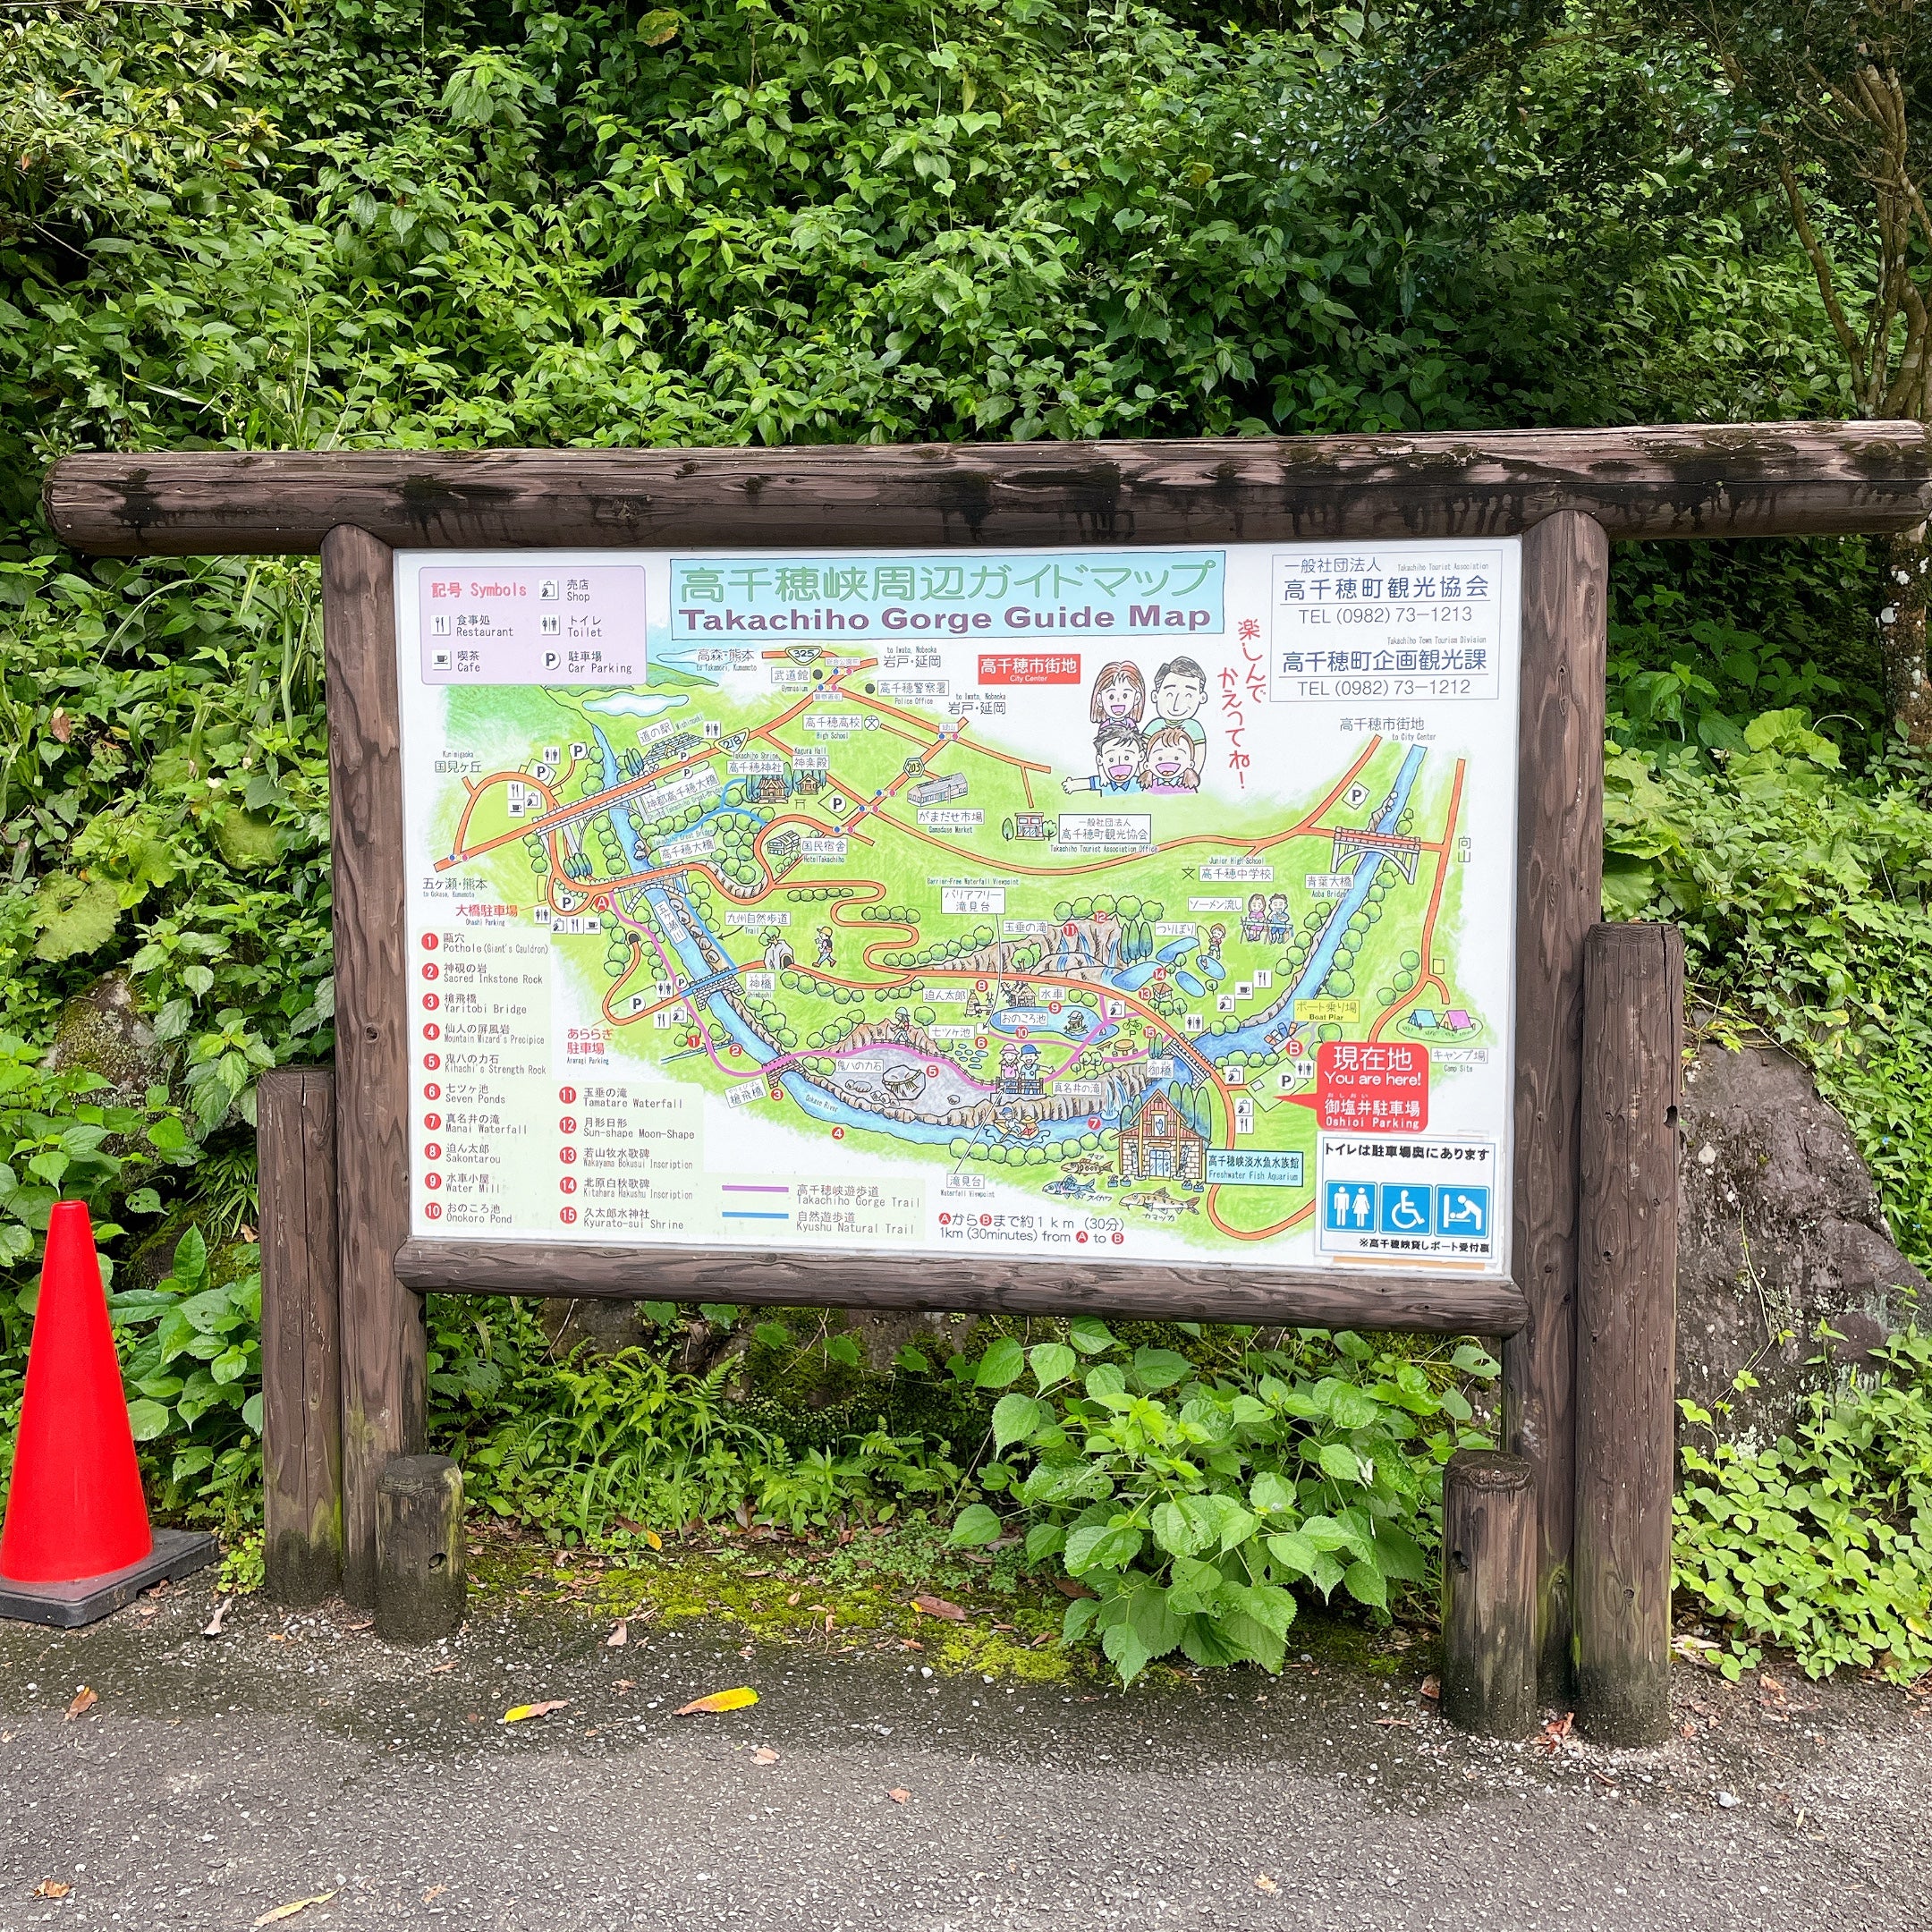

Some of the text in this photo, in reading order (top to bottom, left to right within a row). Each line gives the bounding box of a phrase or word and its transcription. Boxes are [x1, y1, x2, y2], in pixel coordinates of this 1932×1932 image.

[1284, 556, 1381, 573] 一般社団法人
[567, 579, 589, 591] 売店
[679, 560, 1216, 602] 高千穂峡周辺ガイドマップ
[431, 582, 527, 599] 記号 Symbols
[1284, 575, 1488, 601] 高千穂町観光協会
[567, 592, 589, 603] Shop
[456, 614, 490, 625] 食事処
[570, 615, 602, 625] トイレ
[679, 605, 1210, 634] Takachiho Gorge Guide Map
[1299, 609, 1332, 624] TEL
[1336, 607, 1391, 624] (0982)
[456, 627, 513, 637] Restaurant
[568, 627, 602, 638] Toilet
[457, 650, 479, 661] 喫茶
[568, 650, 602, 662] 駐車場
[698, 648, 754, 662] 高森・熊本
[793, 649, 815, 658] 325
[883, 655, 941, 668] 岩戸・延岡
[980, 657, 1077, 674] 高千穂市街地
[1238, 618, 1266, 703] 楽しんで
[1283, 648, 1487, 673] 高千穂町企画観光課
[457, 662, 480, 672] Cafe
[568, 664, 632, 674] Car Parking
[774, 670, 809, 682] 武道館
[1009, 674, 1048, 683] City Center
[879, 682, 946, 694] 高千穂警察署
[1297, 681, 1330, 697] TEL
[1335, 680, 1389, 697] (0982)
[947, 701, 1006, 715] 岩戸・延岡
[805, 716, 860, 728] 高千穂高校
[1339, 716, 1425, 731] 高千穂市街地
[640, 721, 671, 742] 道の駅
[723, 735, 742, 750] 218
[729, 762, 783, 774] 高千穂神社
[794, 757, 827, 768] 神楽殿
[919, 810, 983, 823] がまだせ市場
[1078, 818, 1131, 827] 一般社団法人
[1061, 828, 1148, 841] 高千穂町観光協会
[662, 840, 715, 860] 高千穂大橋
[801, 840, 846, 852] 国民宿舎
[1457, 836, 1471, 863] 向山
[1201, 868, 1272, 880] 高千穂中学校
[1307, 876, 1352, 887] 青葉大橋
[945, 889, 1002, 900] バリアフリー
[455, 904, 519, 918] 大橋駐車場
[955, 901, 990, 912] 滝見台
[1189, 900, 1241, 911] ソーメン流し
[727, 913, 789, 924] 九州自然歩道
[745, 927, 759, 935] Trail
[1004, 921, 1047, 934] 玉垂の滝
[1157, 924, 1195, 935] つりぼり
[444, 962, 487, 974] 神硯の岩
[444, 973, 543, 985] Sacred Inkstone Rock
[749, 979, 772, 990] 神橋
[924, 989, 966, 1001] 迫ん太郎
[1040, 988, 1063, 1000] 水車
[444, 1004, 527, 1016] Yaritobi Bridge
[1296, 1001, 1357, 1013] ボート乗り場
[1001, 1013, 1046, 1024] おのころ池
[445, 1022, 511, 1035] 仙人の屏風岩
[567, 1028, 614, 1041] あららぎ
[444, 1033, 475, 1044] Mountain
[510, 1035, 545, 1046] Precipice
[566, 1042, 605, 1055] 駐車場
[445, 1053, 500, 1064] 鬼八の力石
[1333, 1046, 1412, 1072] 現在地
[1433, 1049, 1487, 1062] キャンプ場
[488, 1063, 525, 1075] Strength
[528, 1064, 547, 1075] Rock
[837, 1061, 882, 1072] 鬼八の力石
[1324, 1071, 1421, 1086] You are here!
[583, 1087, 628, 1098] 玉垂の滝
[1054, 1082, 1101, 1095] 真名井の滝
[445, 1093, 506, 1105] Seven Ponds
[583, 1097, 683, 1109] Tamatare Waterfall
[1325, 1098, 1420, 1117] 御塩井駐車場
[445, 1113, 500, 1125] 真名井の滝
[583, 1117, 628, 1129] 月形日形
[1326, 1116, 1419, 1130] Oshioi Parking
[445, 1123, 528, 1136] Manai Waterfall
[583, 1128, 695, 1140] Sun-shape Moon-Shape
[446, 1143, 489, 1155] 迫ん太郎
[583, 1148, 650, 1159] 若山牧水歌碑
[1326, 1142, 1490, 1161] トイレは駐車場奥にあります
[445, 1154, 501, 1165] Sakontarou
[649, 1159, 693, 1171] Inscription
[1208, 1154, 1300, 1169] 高千穂峡淡水魚水族館
[446, 1173, 490, 1184] 水車小屋
[949, 1175, 982, 1187] 滝見台
[1208, 1169, 1299, 1181] Freshwater Fish Aquarium
[445, 1182, 500, 1194] Water Mill
[584, 1177, 650, 1190] 北原白秋歌碑
[583, 1188, 615, 1199] Kitahara
[649, 1190, 693, 1200] Inscription
[797, 1184, 879, 1198] 高千穂峡遊歩道
[796, 1194, 920, 1208] Takachiho Gorge Trail
[446, 1203, 501, 1215] おのころ池
[584, 1208, 650, 1220] 久太郎水神社
[446, 1213, 513, 1224] Onokoro Pond
[798, 1210, 856, 1224] 自然遊歩道
[649, 1219, 684, 1230] Shrine
[796, 1221, 914, 1234] Kyushu Natural Trail
[940, 1227, 963, 1239] 1km
[966, 1228, 1038, 1242] (30minutes)
[1041, 1230, 1072, 1242] from
[1094, 1233, 1106, 1243] to
